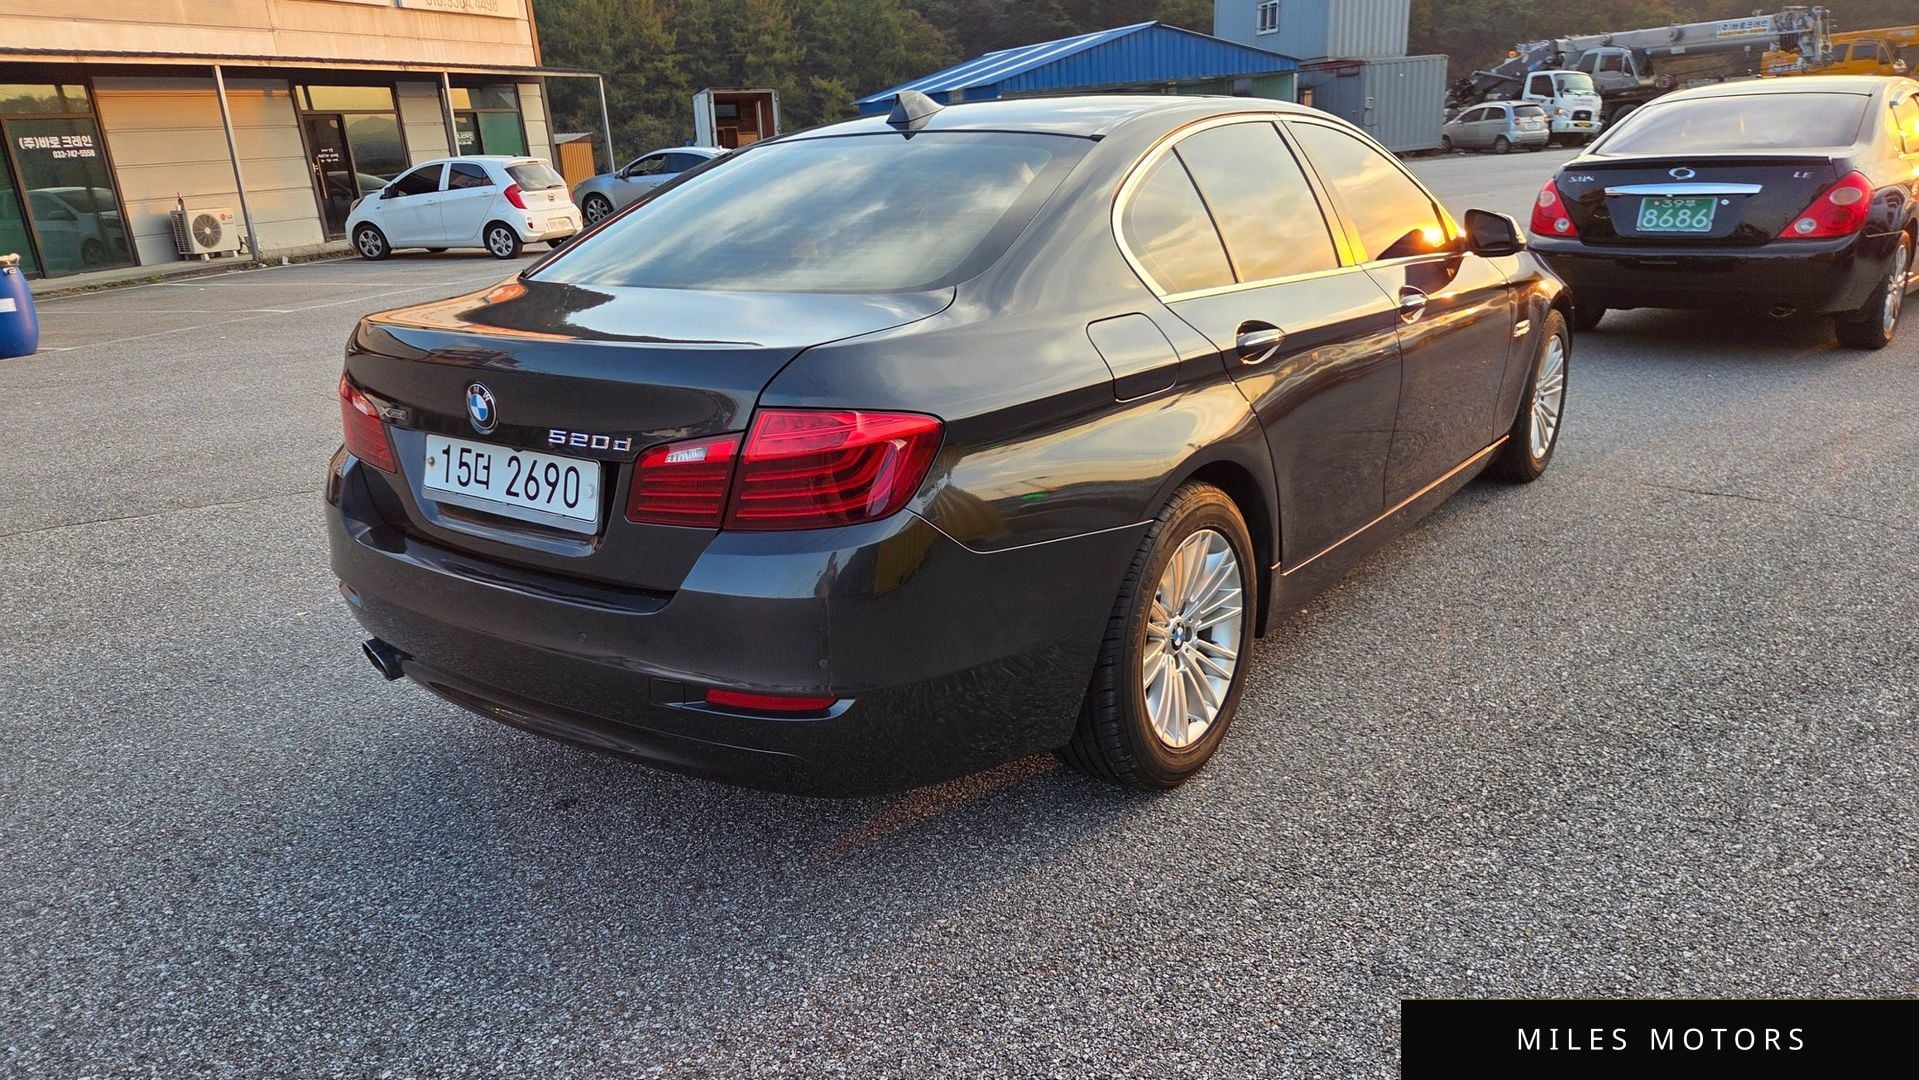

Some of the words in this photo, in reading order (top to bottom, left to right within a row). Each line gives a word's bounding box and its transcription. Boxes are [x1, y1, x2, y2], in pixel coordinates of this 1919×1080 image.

[62, 135, 93, 148] 크레인
[1642, 208, 1708, 228] 8686
[548, 429, 632, 452] 520d
[442, 444, 491, 490] 15더
[506, 455, 580, 509] 2690
